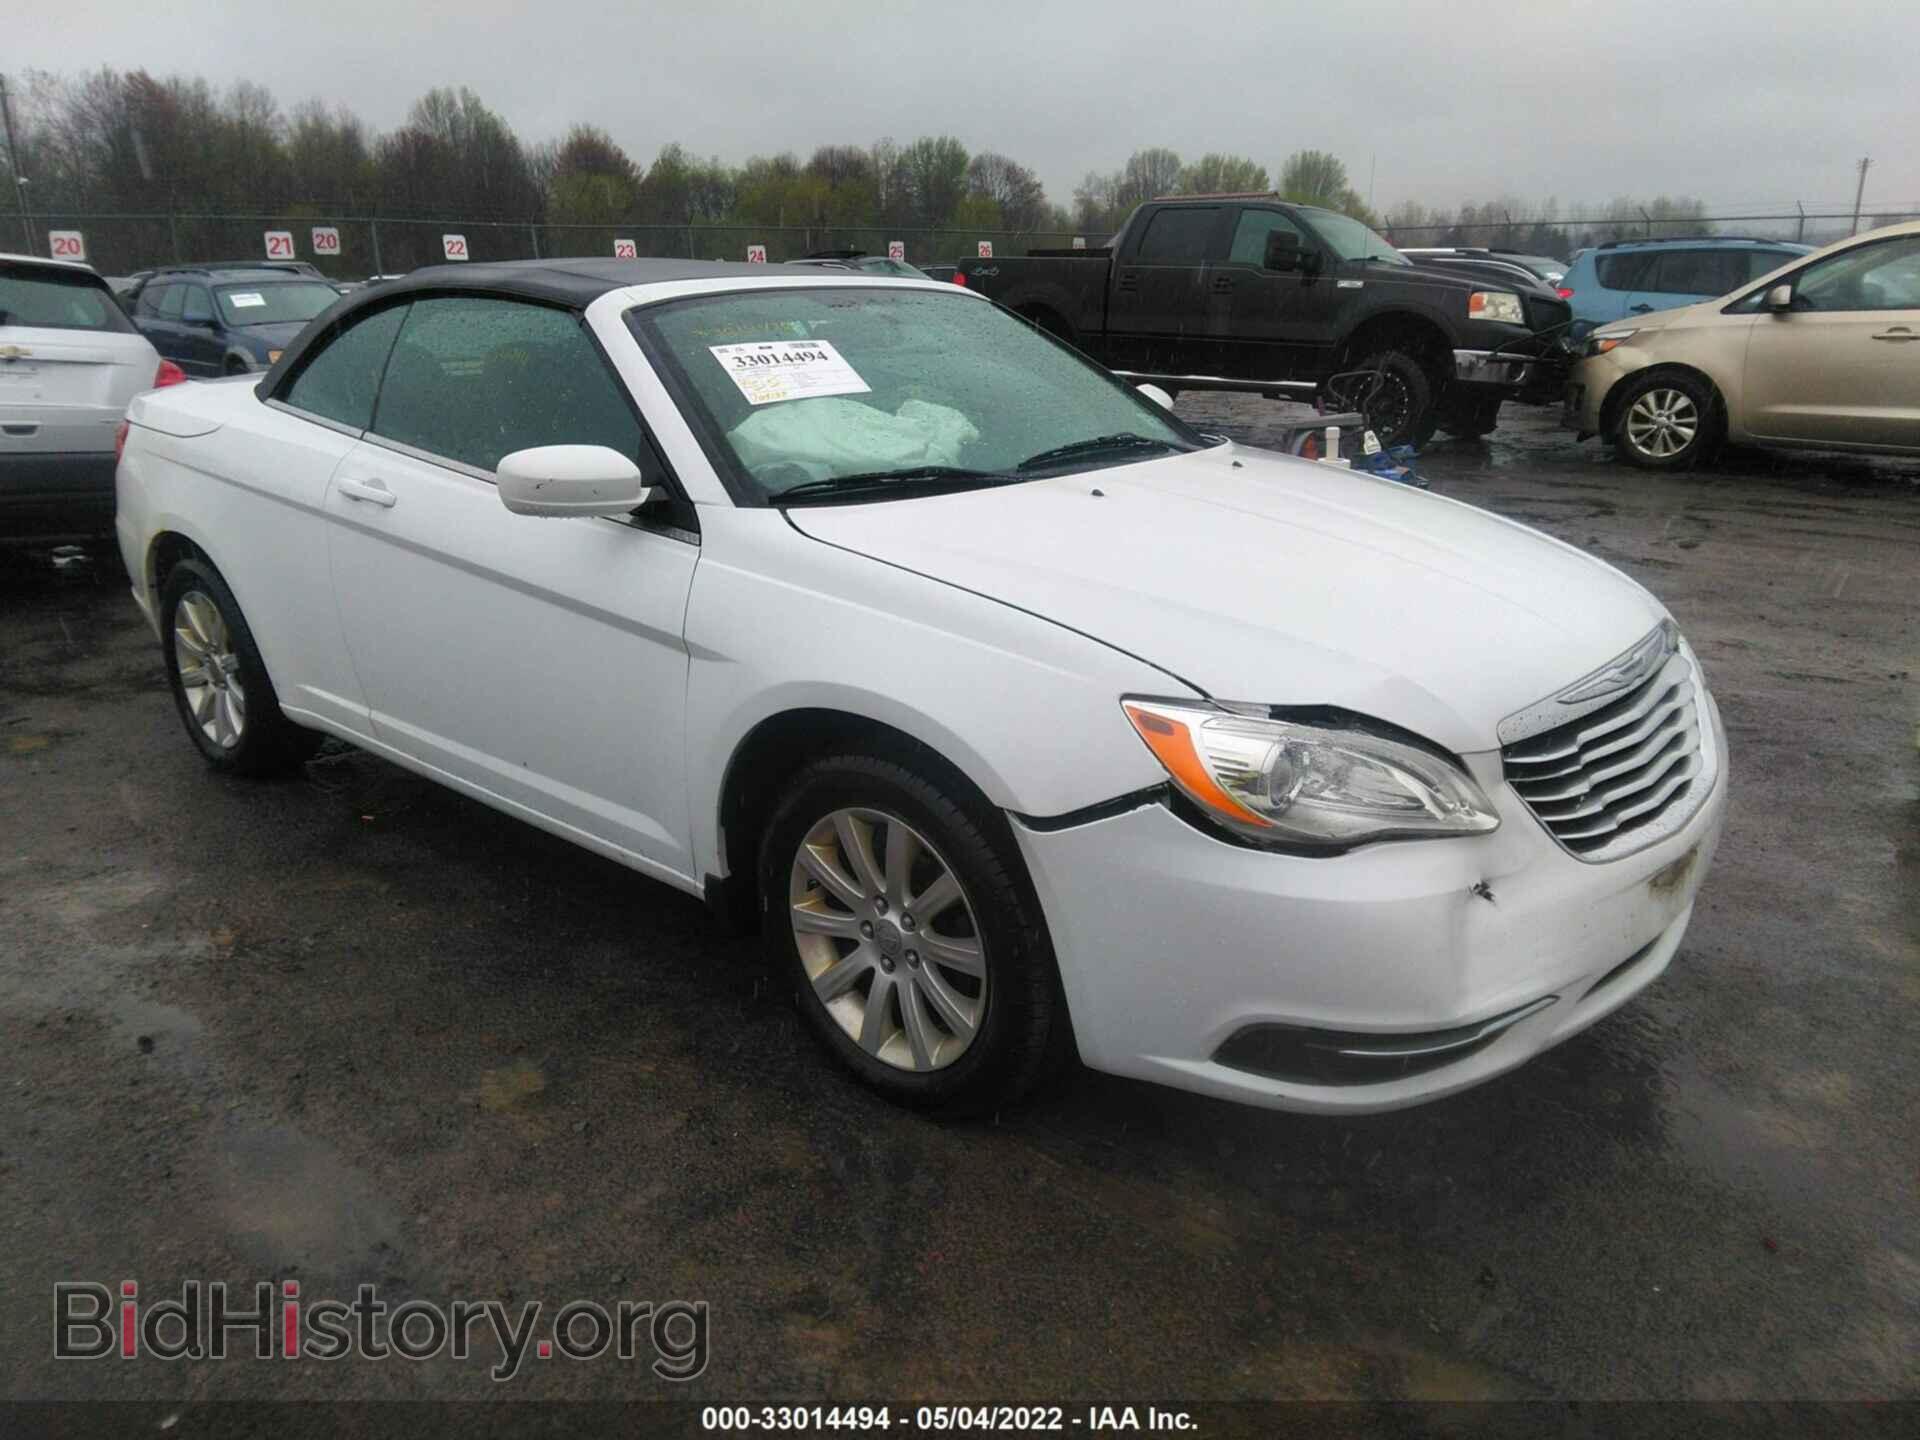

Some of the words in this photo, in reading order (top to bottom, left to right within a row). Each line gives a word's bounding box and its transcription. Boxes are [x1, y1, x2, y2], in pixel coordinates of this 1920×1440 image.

[53, 238, 81, 257] 20
[268, 237, 293, 256] 21
[316, 233, 338, 251] 20
[446, 240, 464, 256] 22
[616, 244, 635, 258] 23
[750, 250, 765, 263] 24
[890, 246, 903, 258] 25
[979, 244, 991, 257] 26
[731, 350, 829, 368] 33014494
